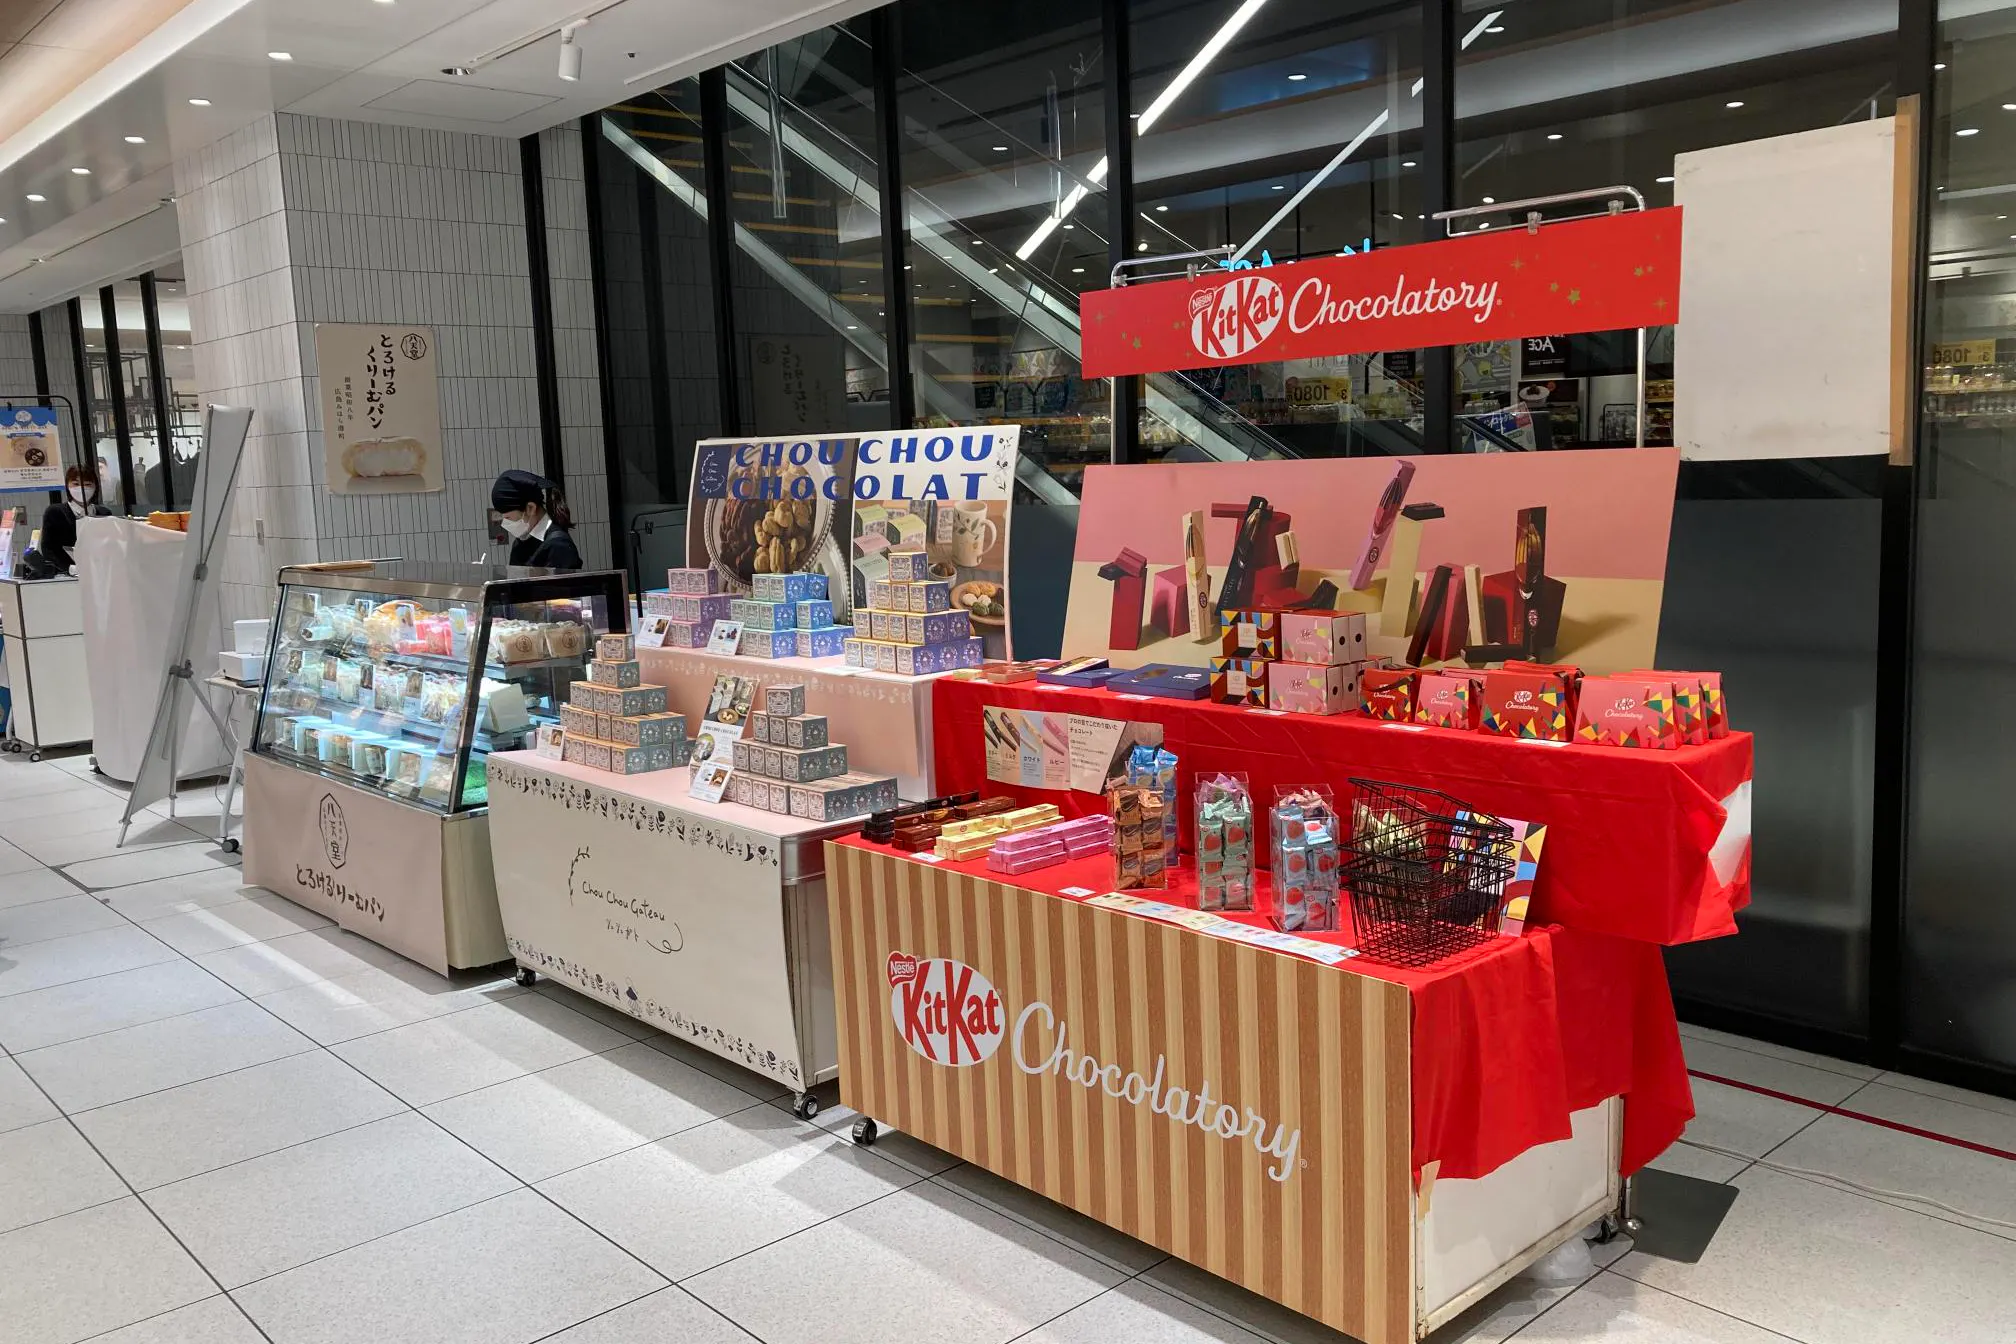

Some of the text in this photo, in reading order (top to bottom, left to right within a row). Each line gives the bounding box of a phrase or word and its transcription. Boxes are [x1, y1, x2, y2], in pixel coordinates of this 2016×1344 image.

[1201, 274, 1498, 358] KitKat Chocolatory
[366, 345, 384, 429] くりーむパン
[380, 334, 396, 396] とろける
[735, 434, 994, 468] CHOU CHOU
[731, 472, 988, 501] CHOCOLAT
[327, 802, 342, 861] 八天堂
[582, 880, 666, 921] Chou Chou Gateau
[902, 960, 1301, 1183] KitKat Chocolatory
